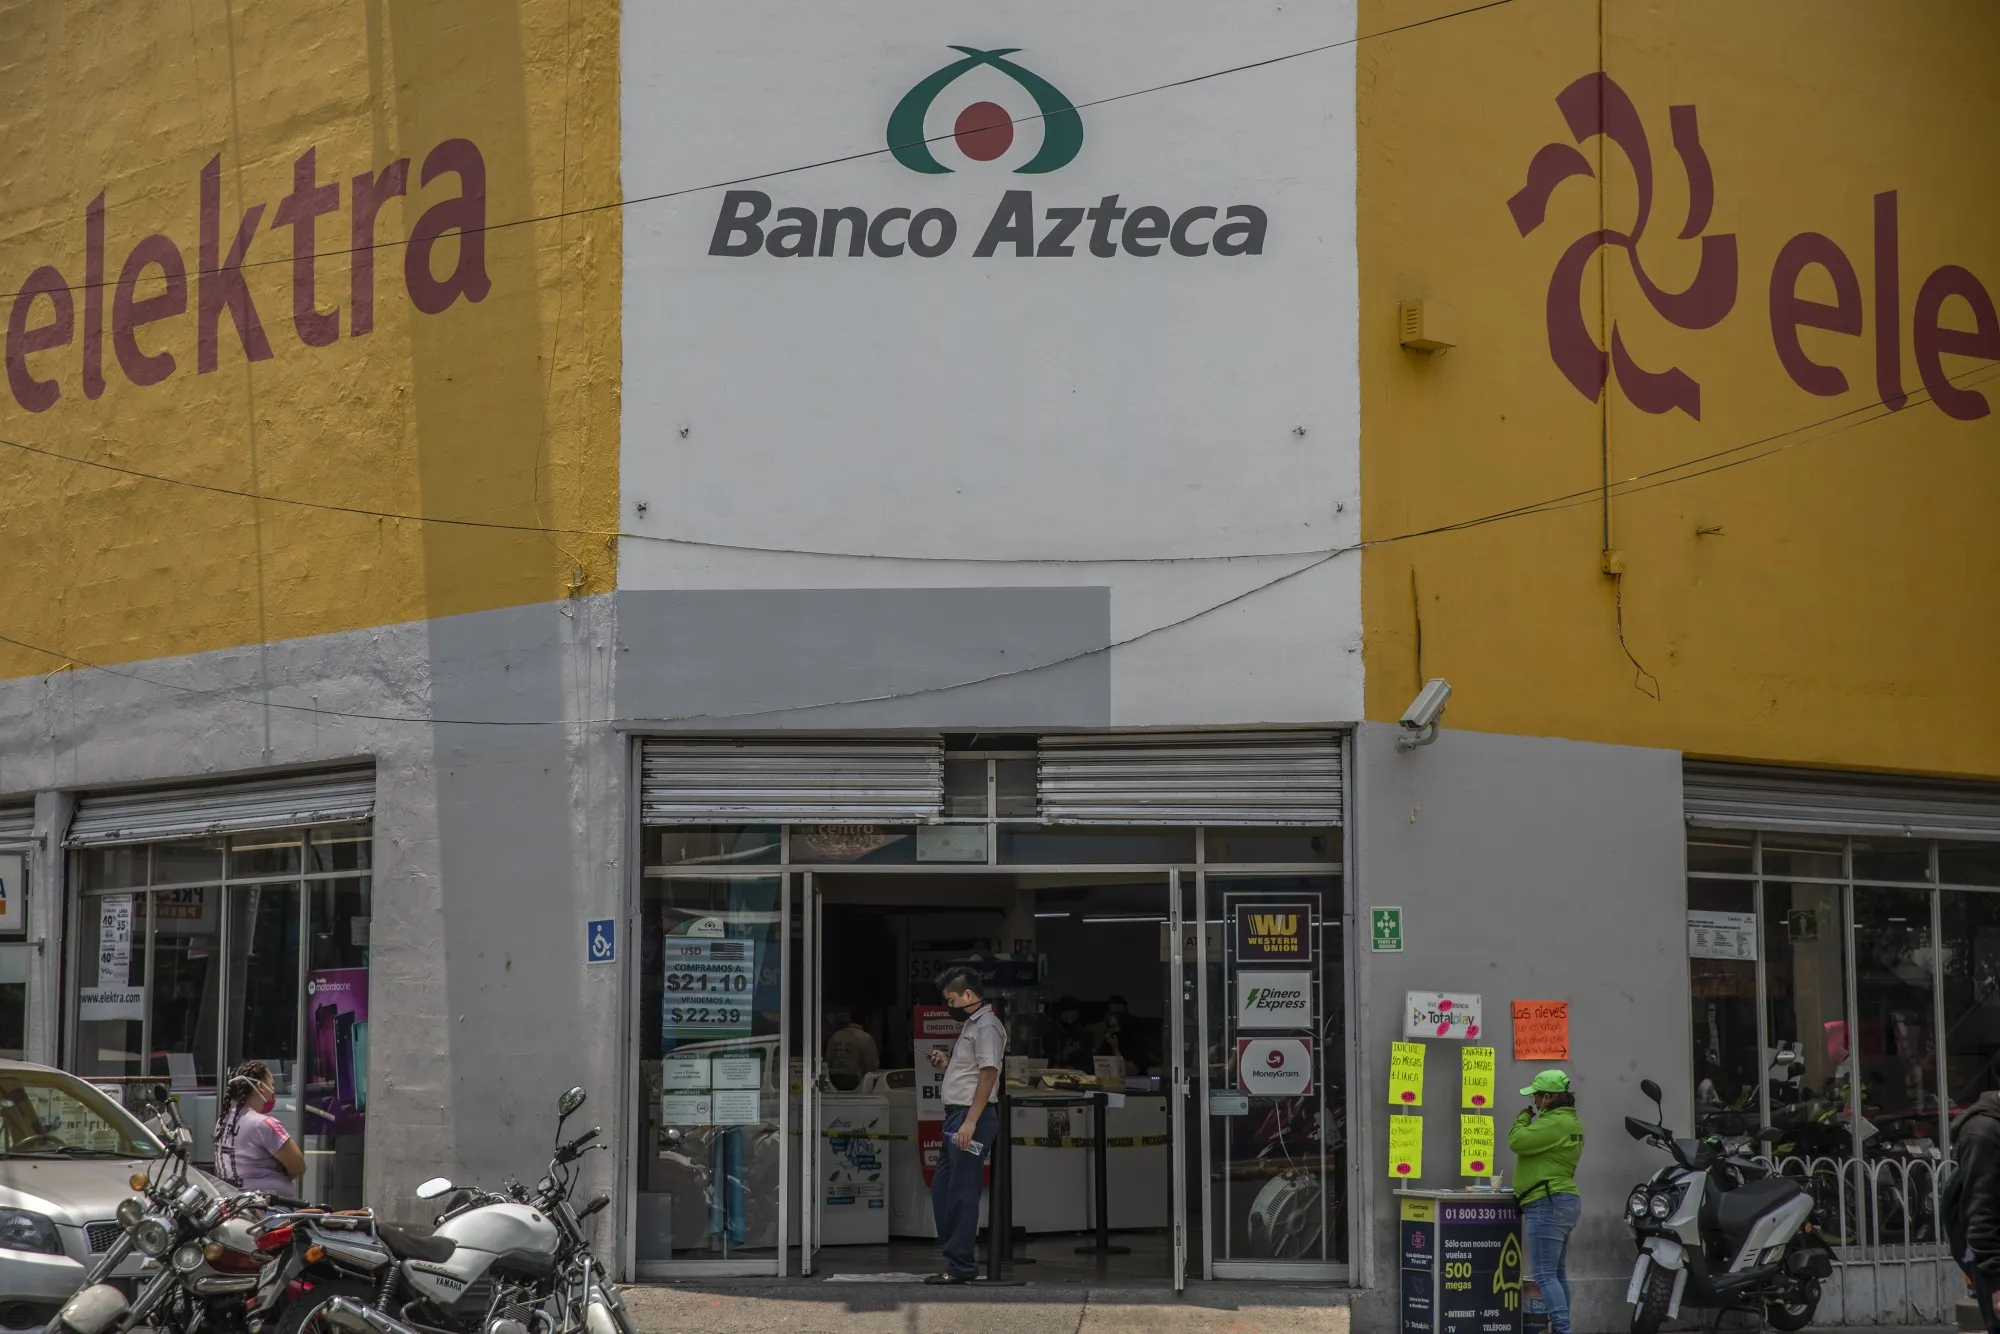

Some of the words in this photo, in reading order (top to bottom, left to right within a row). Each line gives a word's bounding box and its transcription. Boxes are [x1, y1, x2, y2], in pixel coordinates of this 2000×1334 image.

[708, 190, 957, 258] Banco
[973, 190, 1268, 258] Azteca
[5, 138, 492, 413] elektra
[1248, 914, 1298, 935] WU
[681, 946, 702, 956] USD
[674, 964, 733, 973] COMPRAMOS
[667, 973, 747, 993] $21.10
[80, 992, 140, 1003] www.elektra.com
[1261, 988, 1300, 998] Dinero
[1256, 998, 1306, 1011] Express
[671, 1007, 741, 1024] $22.39
[1428, 1011, 1474, 1029] Totalplay
[1394, 1043, 1420, 1054] INICIAL
[1252, 1070, 1299, 1078] MoneyGram
[1445, 1208, 1458, 1219] 01
[1459, 1208, 1477, 1219] 800
[1478, 1208, 1496, 1219] 330
[1444, 1239, 1459, 1248] Sólo
[1472, 1240, 1501, 1248] nosotros
[1446, 1251, 1467, 1259] vuelas
[1445, 1262, 1472, 1279] 500
[436, 1276, 462, 1292] YAMAHA
[1445, 1281, 1472, 1292] megas
[1448, 1310, 1476, 1318] INTERNET
[1483, 1309, 1499, 1317] APPS
[1448, 1325, 1456, 1333] TV
[1483, 1324, 1512, 1332] TELÉFONO
